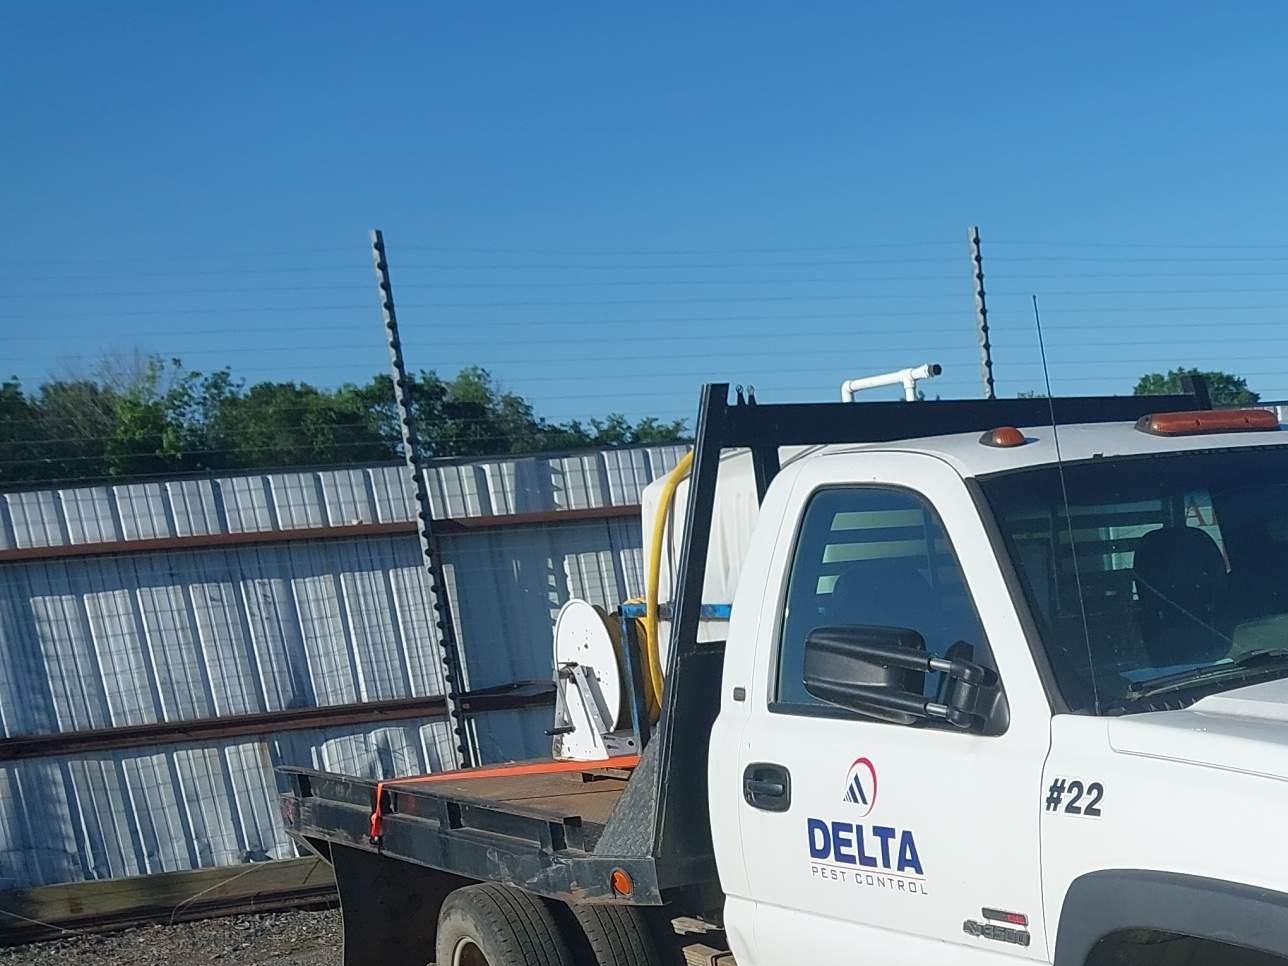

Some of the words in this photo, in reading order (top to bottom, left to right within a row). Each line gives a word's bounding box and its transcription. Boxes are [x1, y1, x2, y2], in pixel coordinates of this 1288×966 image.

[1045, 778, 1104, 817] #22
[807, 817, 924, 875] DELTA
[811, 866, 847, 883] PEST
[855, 873, 928, 895] CONTROL
